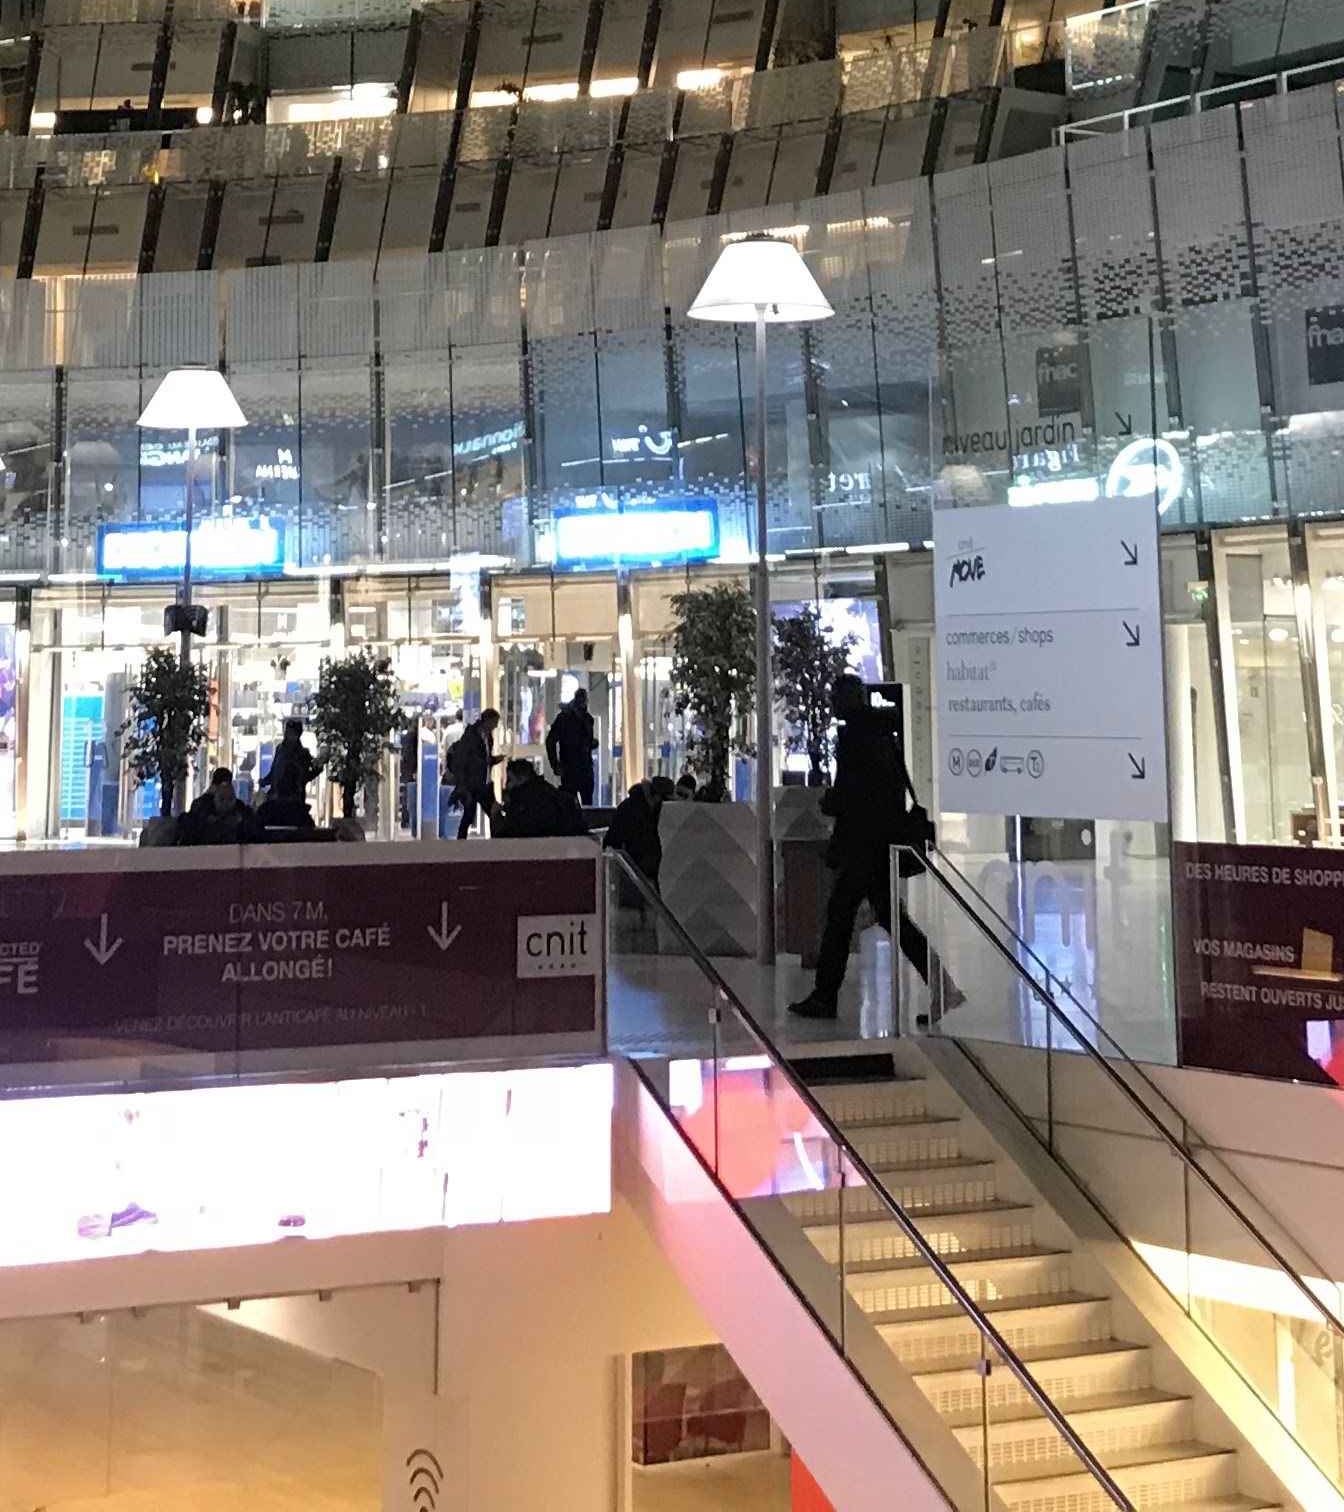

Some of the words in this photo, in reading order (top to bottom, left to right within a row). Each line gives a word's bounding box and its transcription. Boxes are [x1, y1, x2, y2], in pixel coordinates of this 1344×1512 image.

[1037, 361, 1077, 382] fnac
[943, 429, 1008, 455] niveau
[1013, 414, 1076, 455] jardin
[945, 630, 1010, 646] commerces
[1018, 626, 1054, 648] shops
[948, 696, 1018, 716] restaurants,
[1185, 862, 1212, 881] DES
[1214, 864, 1270, 885] HEURES
[1272, 867, 1291, 886] DE
[229, 901, 287, 926] DANS
[163, 932, 252, 957] PRENEZ
[258, 928, 330, 953] VOTRE
[335, 922, 391, 949] CAFÉ
[525, 920, 588, 958] cnit
[1193, 938, 1220, 958] VOS
[1222, 940, 1296, 965] MAGASINS
[221, 955, 334, 983] ALLONGÉ!
[1199, 981, 1258, 1005] RESTENT
[1260, 986, 1324, 1011] OUVERTS
